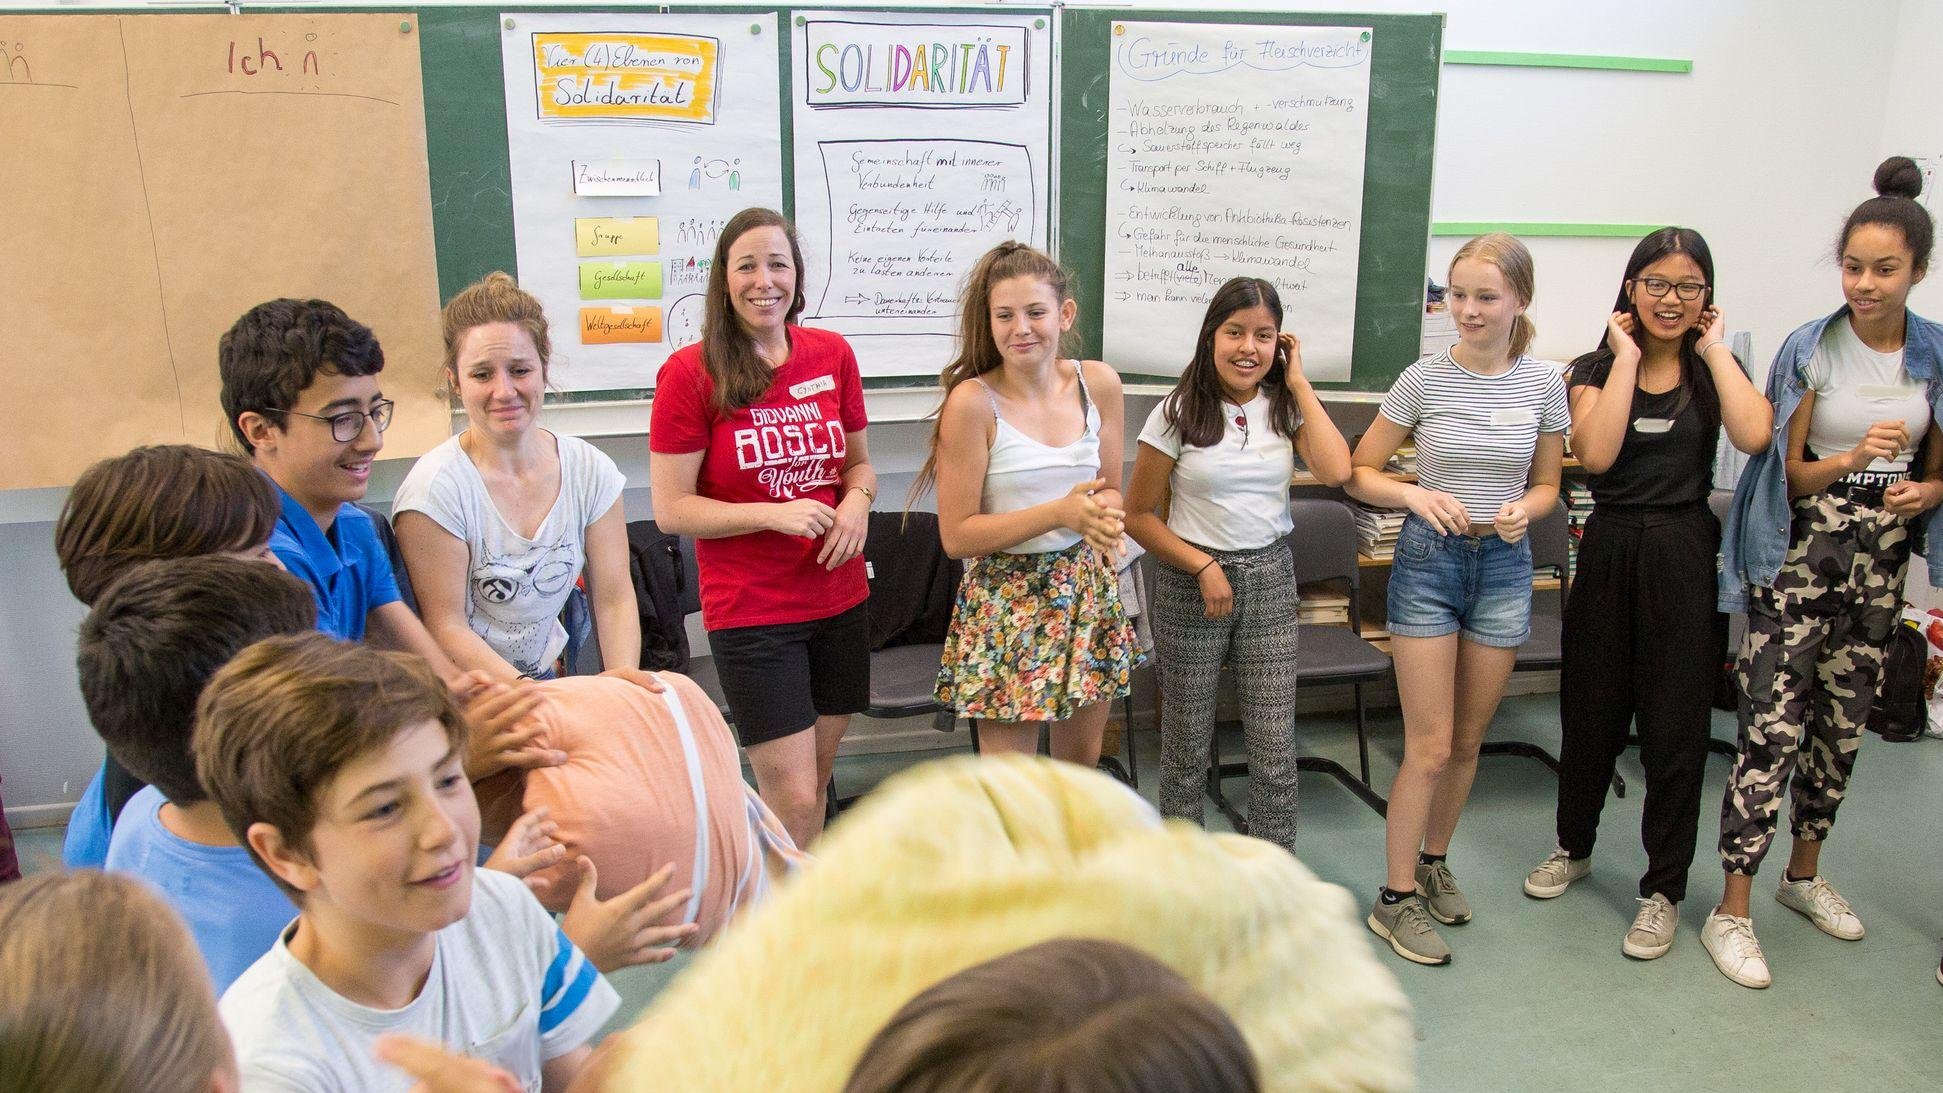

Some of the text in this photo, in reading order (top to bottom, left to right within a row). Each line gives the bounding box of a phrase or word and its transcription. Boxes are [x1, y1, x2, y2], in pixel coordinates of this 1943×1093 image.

[228, 37, 282, 76] Ich
[542, 44, 577, 69] Vier
[612, 45, 665, 68] Ebenen
[1128, 37, 1362, 69] Gründe für Fleischverzicht
[815, 37, 1011, 94] SOLIDARITÄT
[555, 78, 686, 105] Solidarität
[1127, 97, 1244, 117] Wasserverbrauch
[1129, 116, 1310, 141] Abholzung des Regenwaldes
[1142, 138, 1302, 155] Sauerstoffspeicher fällt weg
[851, 150, 1004, 173] Gemeinschaft mit innerer
[1128, 160, 1173, 177] Transport
[1174, 164, 1191, 176] per
[1195, 160, 1228, 176] Schiff
[1238, 161, 1292, 180] Flugzeug
[858, 169, 936, 191] Verbundenheit
[1137, 182, 1210, 195] Klimawandel
[847, 201, 977, 223] Gegenseitige Hilfe und
[1128, 205, 1203, 228] Entwicklung
[1203, 212, 1222, 223] von
[854, 220, 977, 239] Eintreten füreinander
[1133, 227, 1338, 252] Gefahr für die menschliche Gesundheit
[847, 248, 953, 267] Keine eigenen Vorteile
[1176, 261, 1200, 274] alle
[593, 270, 646, 290] Gesellschaft
[852, 267, 865, 275] zu
[1270, 277, 1308, 291] eltweit
[1136, 292, 1161, 303] man
[1165, 289, 1188, 302] kann
[586, 314, 653, 335] Weltgesellschaft
[750, 401, 823, 426] GIOVANNI
[734, 420, 846, 470] BOSCO
[787, 456, 807, 472] for
[758, 459, 828, 498] Youth
